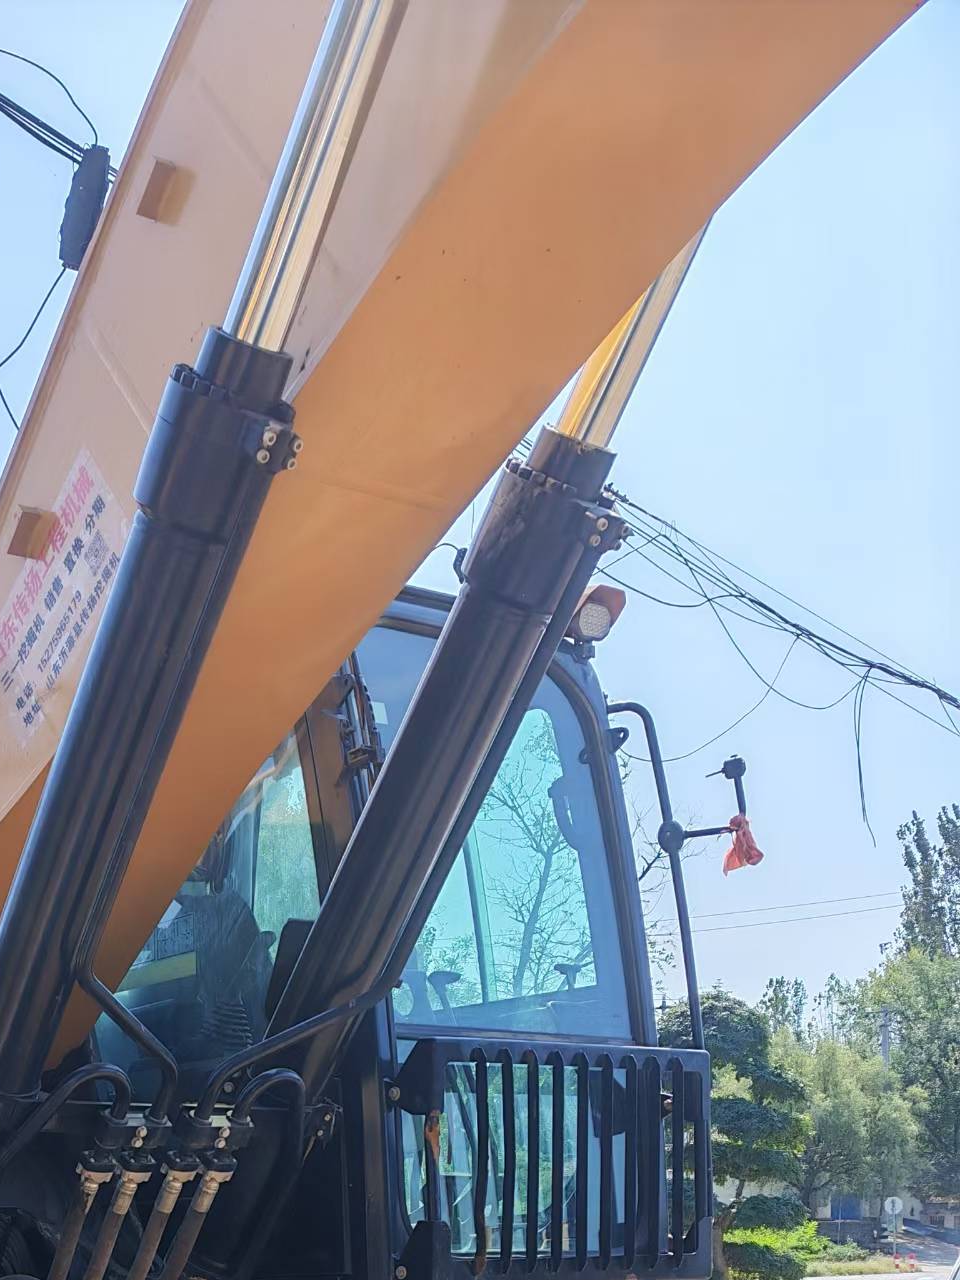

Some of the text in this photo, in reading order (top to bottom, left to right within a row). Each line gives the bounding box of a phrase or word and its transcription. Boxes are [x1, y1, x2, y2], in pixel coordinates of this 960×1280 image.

[1, 494, 106, 692] 三一挖掘机 销售 置换 分期
[37, 590, 82, 673] 15275965179
